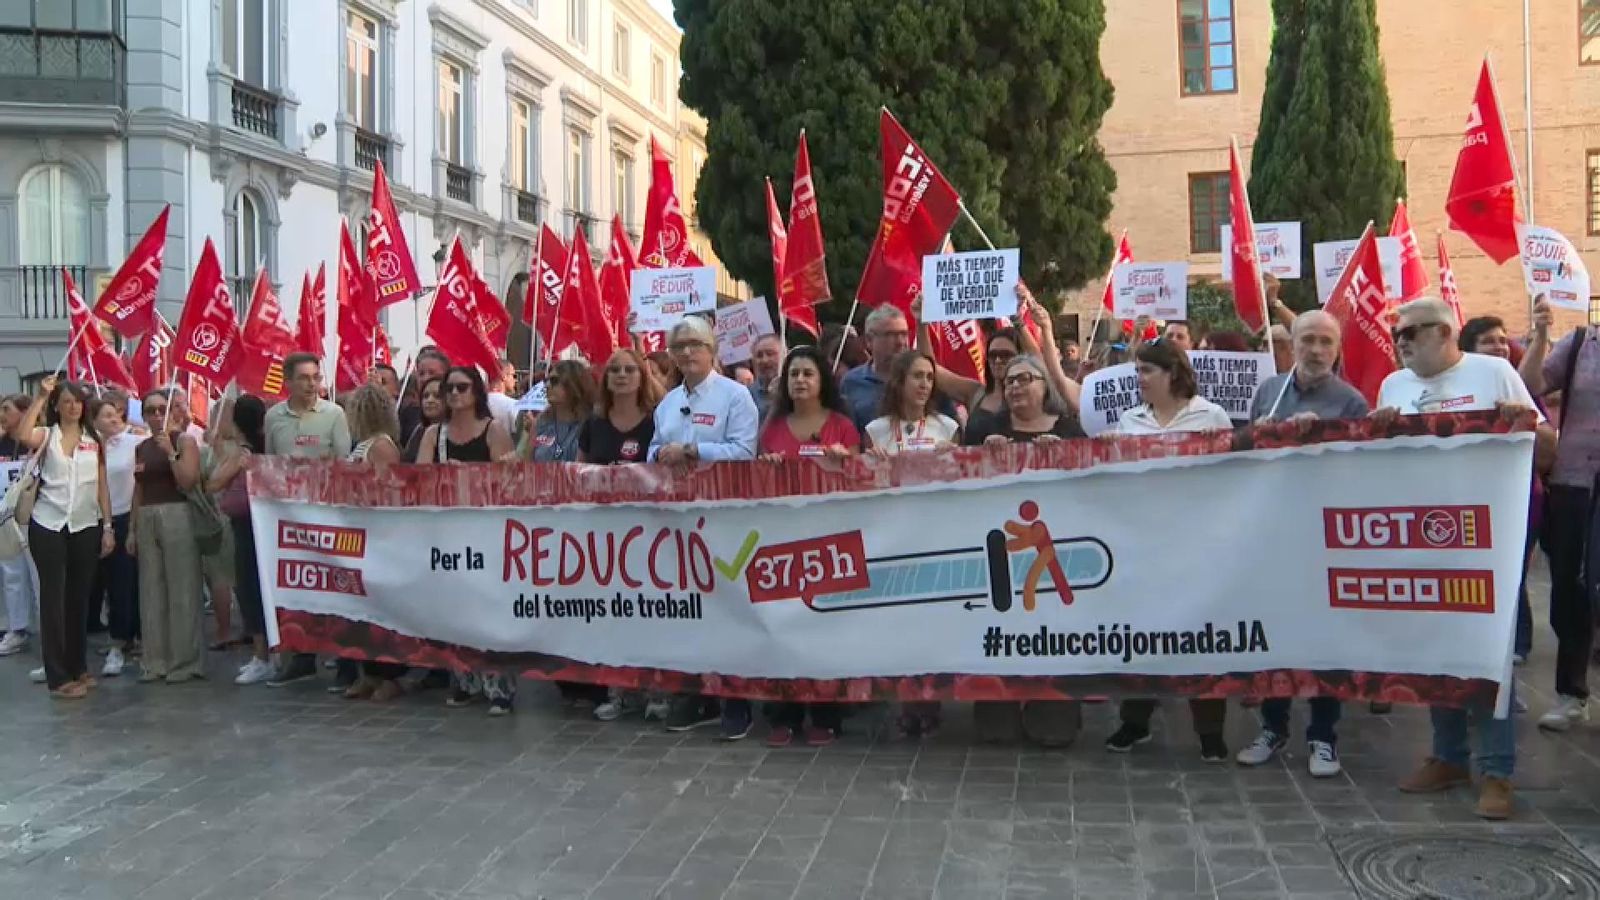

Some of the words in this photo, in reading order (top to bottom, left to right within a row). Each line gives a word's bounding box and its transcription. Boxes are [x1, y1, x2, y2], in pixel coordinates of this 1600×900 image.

[936, 257, 961, 273] MÁS
[965, 256, 1005, 271] TIEMPO
[936, 272, 964, 287] PARA
[967, 271, 981, 286] LO
[984, 270, 1004, 284] QUE
[941, 288, 954, 302] DE
[957, 284, 999, 299] VERDAD
[945, 299, 994, 315] IMPORTA
[1193, 355, 1216, 370] MÁS
[1219, 358, 1257, 372] TIEMPO
[1095, 378, 1116, 396] ENS
[1222, 373, 1234, 385] LO
[1238, 373, 1258, 386] QUE
[1212, 385, 1252, 399] VERDAD
[283, 526, 336, 549] CCOO
[1335, 512, 1415, 546] UGT
[431, 546, 461, 571] Per
[466, 546, 484, 570] la
[503, 516, 715, 593] REDUCCIÓ
[285, 563, 330, 589] UGT
[754, 549, 824, 591] 37,5
[828, 544, 857, 579] h
[1336, 576, 1441, 603] CCOO
[513, 594, 539, 619] del
[544, 595, 607, 623] temps
[611, 592, 635, 618] de
[638, 592, 703, 620] treball
[983, 620, 1270, 663] #reducciójornadaJA
